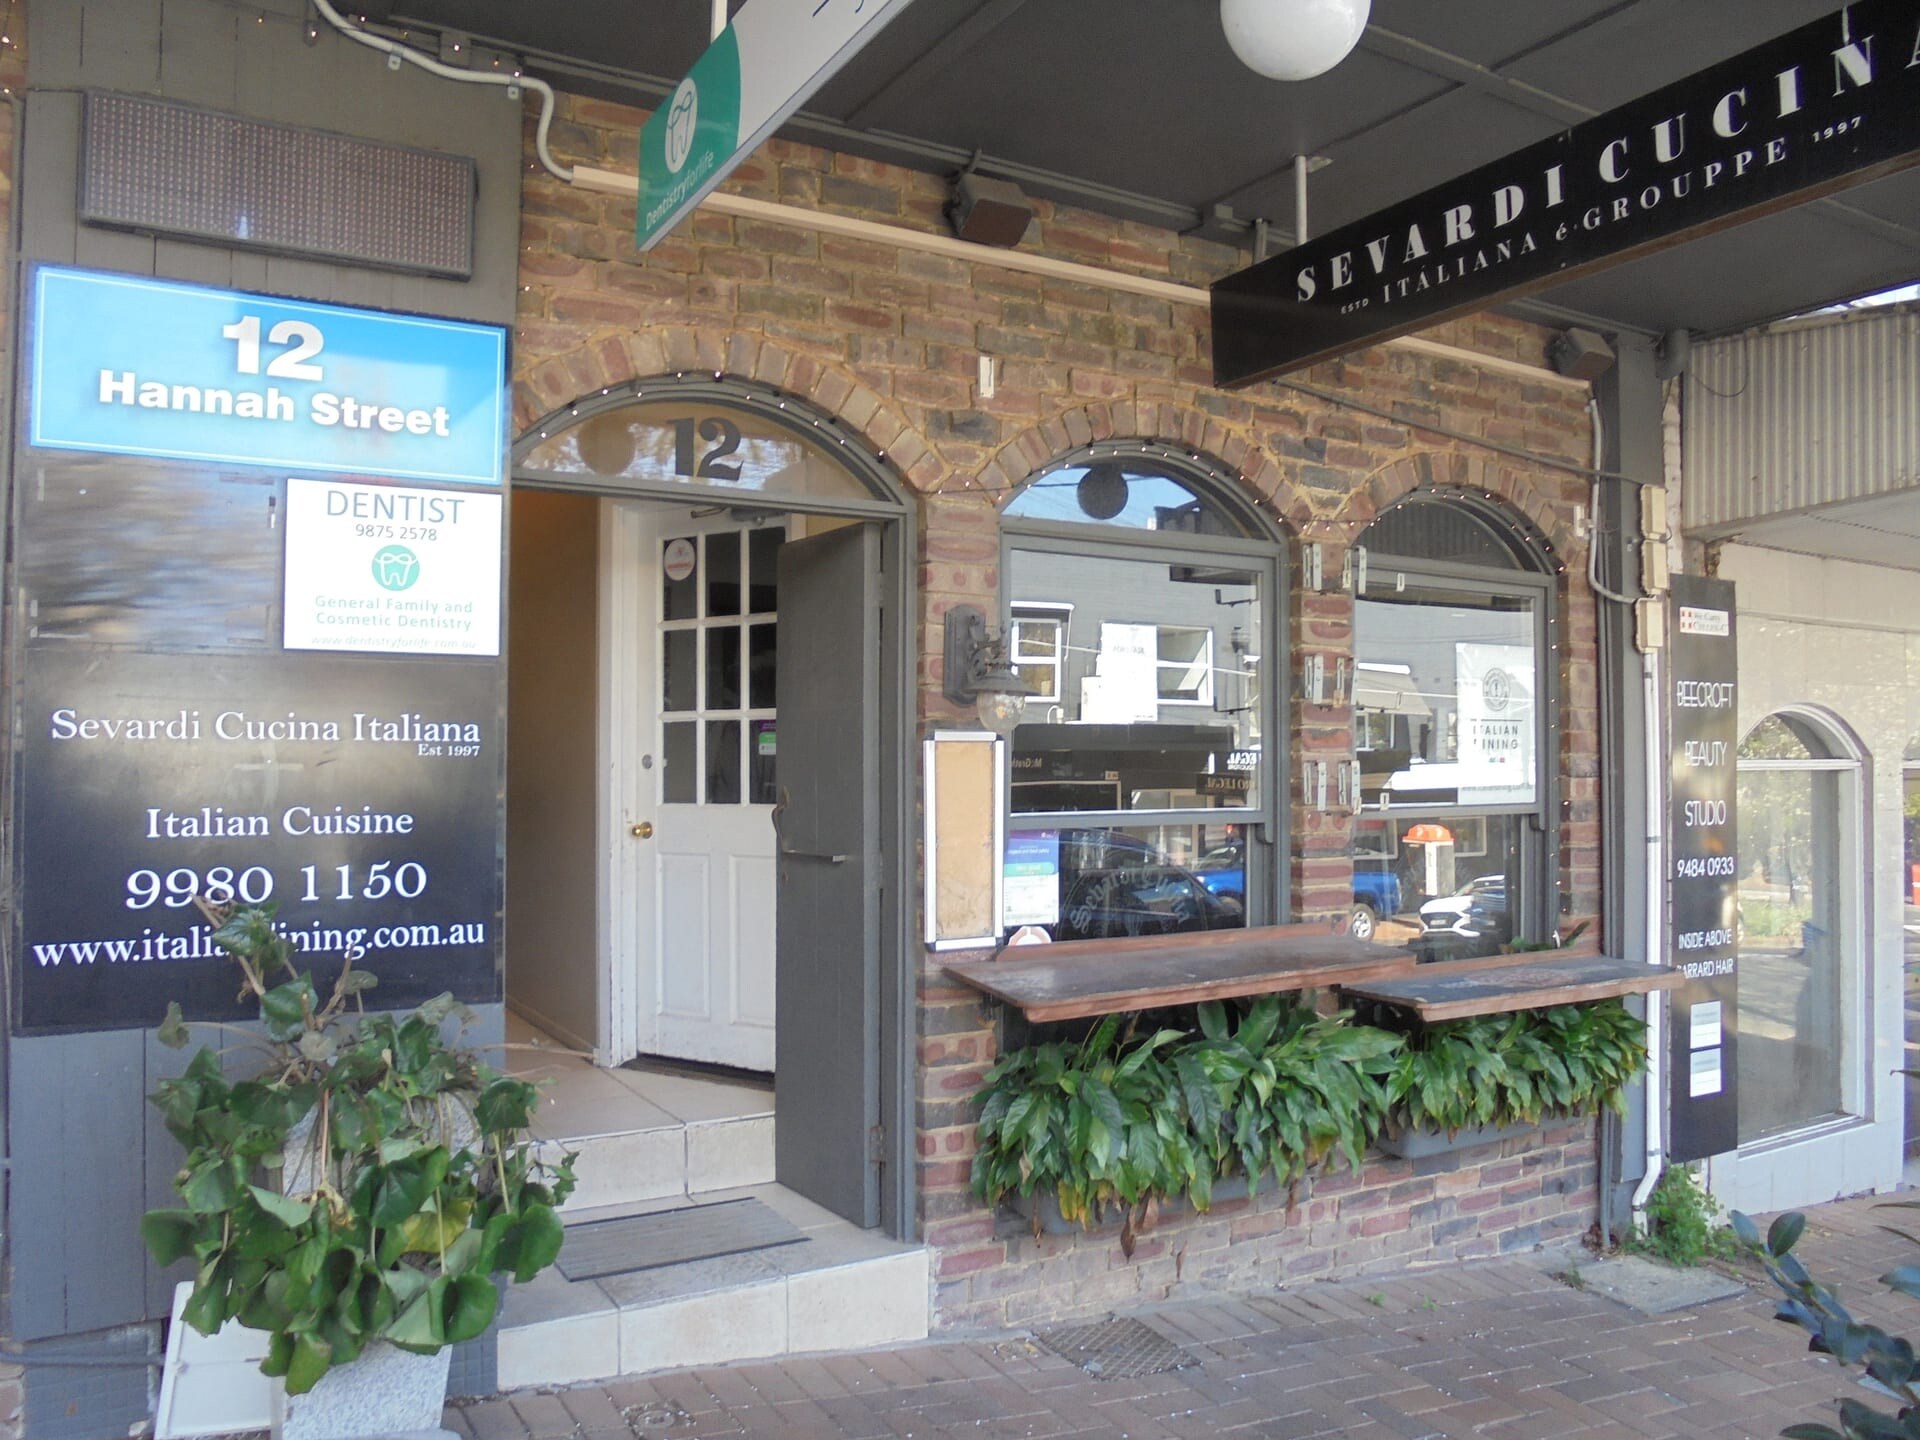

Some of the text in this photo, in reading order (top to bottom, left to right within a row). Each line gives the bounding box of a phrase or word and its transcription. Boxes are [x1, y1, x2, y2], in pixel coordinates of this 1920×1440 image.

[1341, 298, 1369, 314] ESTD
[1583, 137, 1786, 231] GROUPPE
[1812, 116, 1862, 142] 1997
[1297, 163, 1566, 302] SEVARDI
[223, 315, 325, 381] 12
[99, 369, 450, 437] Hannah Street
[666, 416, 744, 481] 12
[327, 490, 465, 524] DENTIST
[355, 523, 437, 541] 9875 2578
[315, 595, 472, 614] General Family and
[316, 612, 472, 631] Cosmetic Dentistry
[1677, 681, 1734, 708] BEECROFT
[51, 709, 480, 743] Sevardi Cucina Italiana
[418, 744, 480, 757] Est 1997
[1684, 741, 1727, 767] BEAUTY
[146, 806, 414, 838] Italian Cuisine
[1685, 800, 1727, 827] STUDIO
[1677, 857, 1734, 878] 9484 0933
[126, 862, 427, 909] 9980 1150
[1679, 929, 1732, 949] INSIDE ABOVE
[1715, 958, 1733, 975] HAIR
